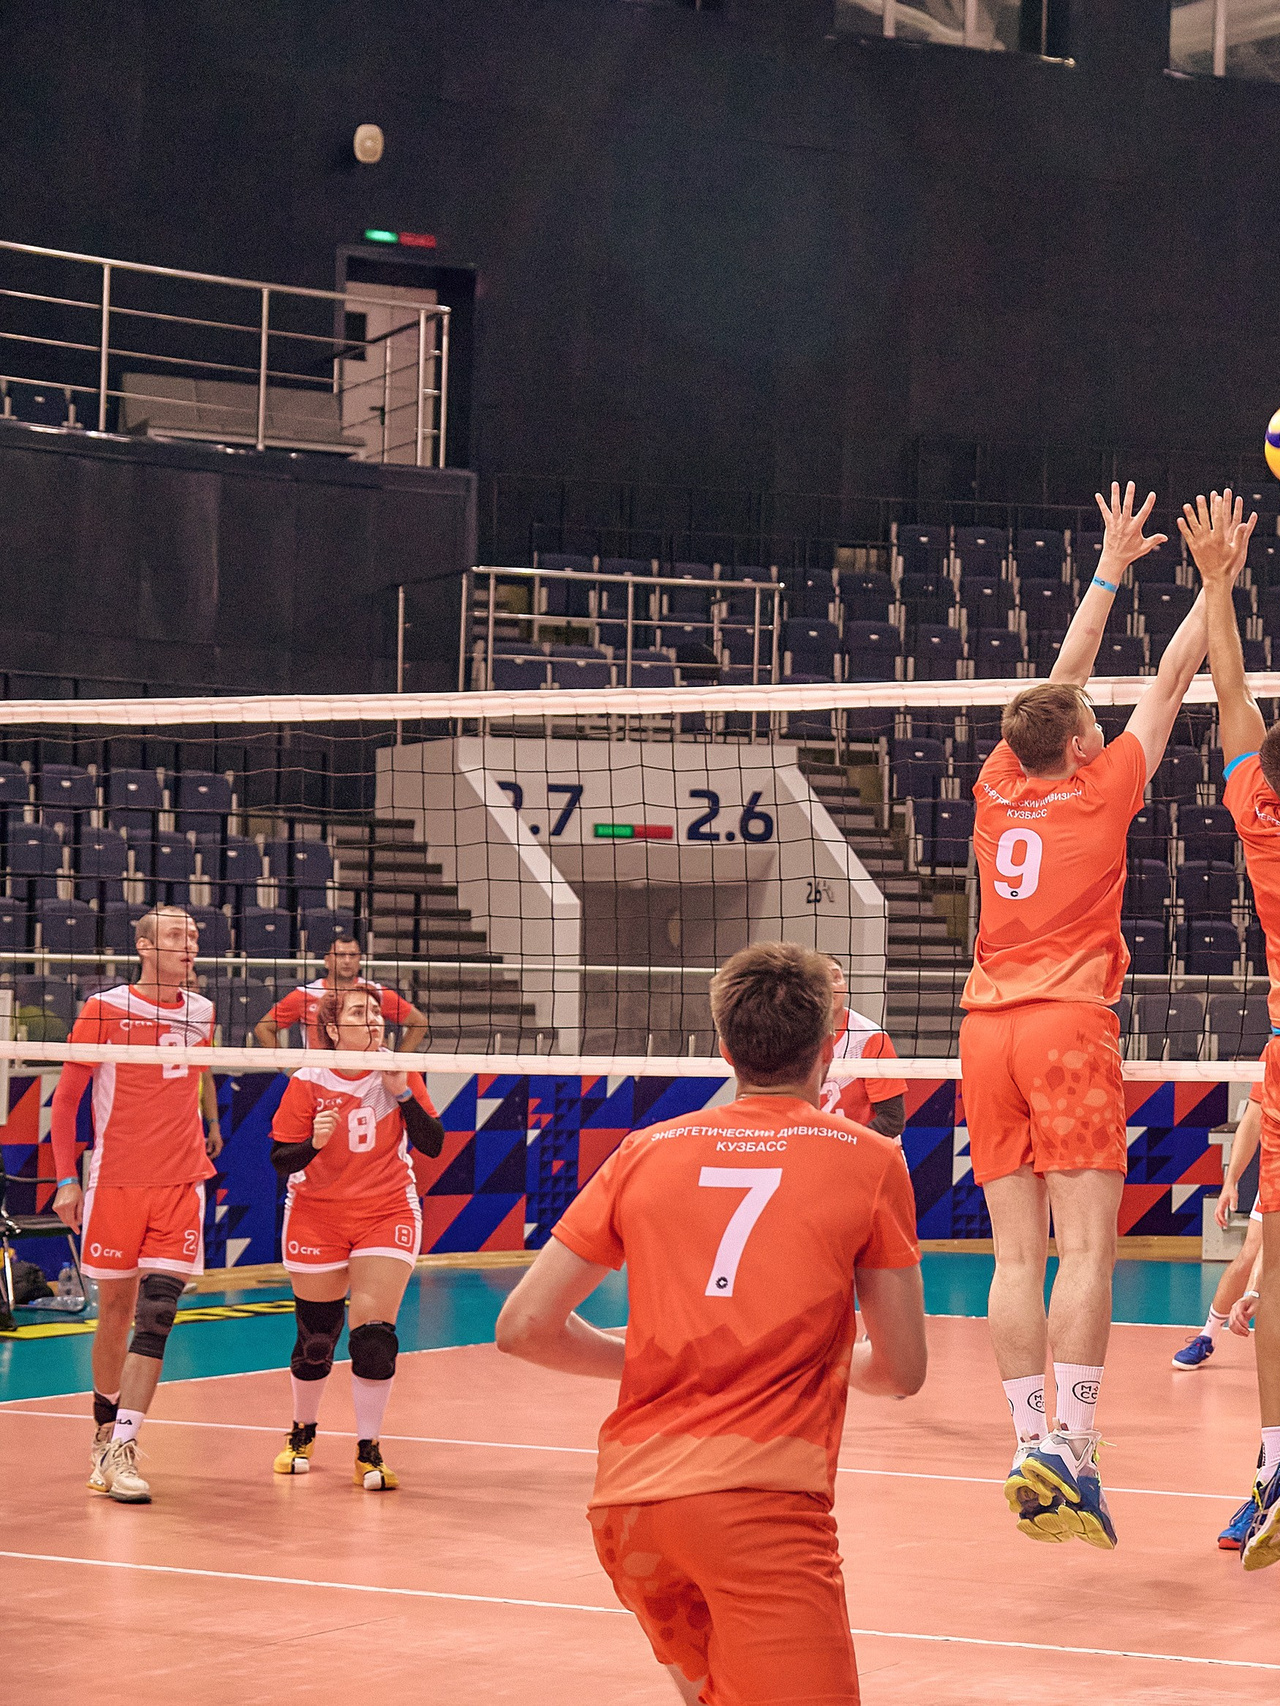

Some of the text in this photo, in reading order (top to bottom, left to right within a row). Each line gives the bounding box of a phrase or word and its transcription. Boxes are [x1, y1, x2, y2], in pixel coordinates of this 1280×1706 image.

[687, 789, 774, 842] 2.6
[1006, 808, 1048, 820] КУЗБАСС
[994, 827, 1043, 900] 9
[348, 1106, 376, 1153] 8
[777, 1126, 858, 1146] ДИВИЗИОН
[716, 1140, 788, 1153] КУЗБАСС
[183, 1229, 198, 1255] 2
[395, 1224, 413, 1248] 8
[698, 1166, 783, 1298] 7
